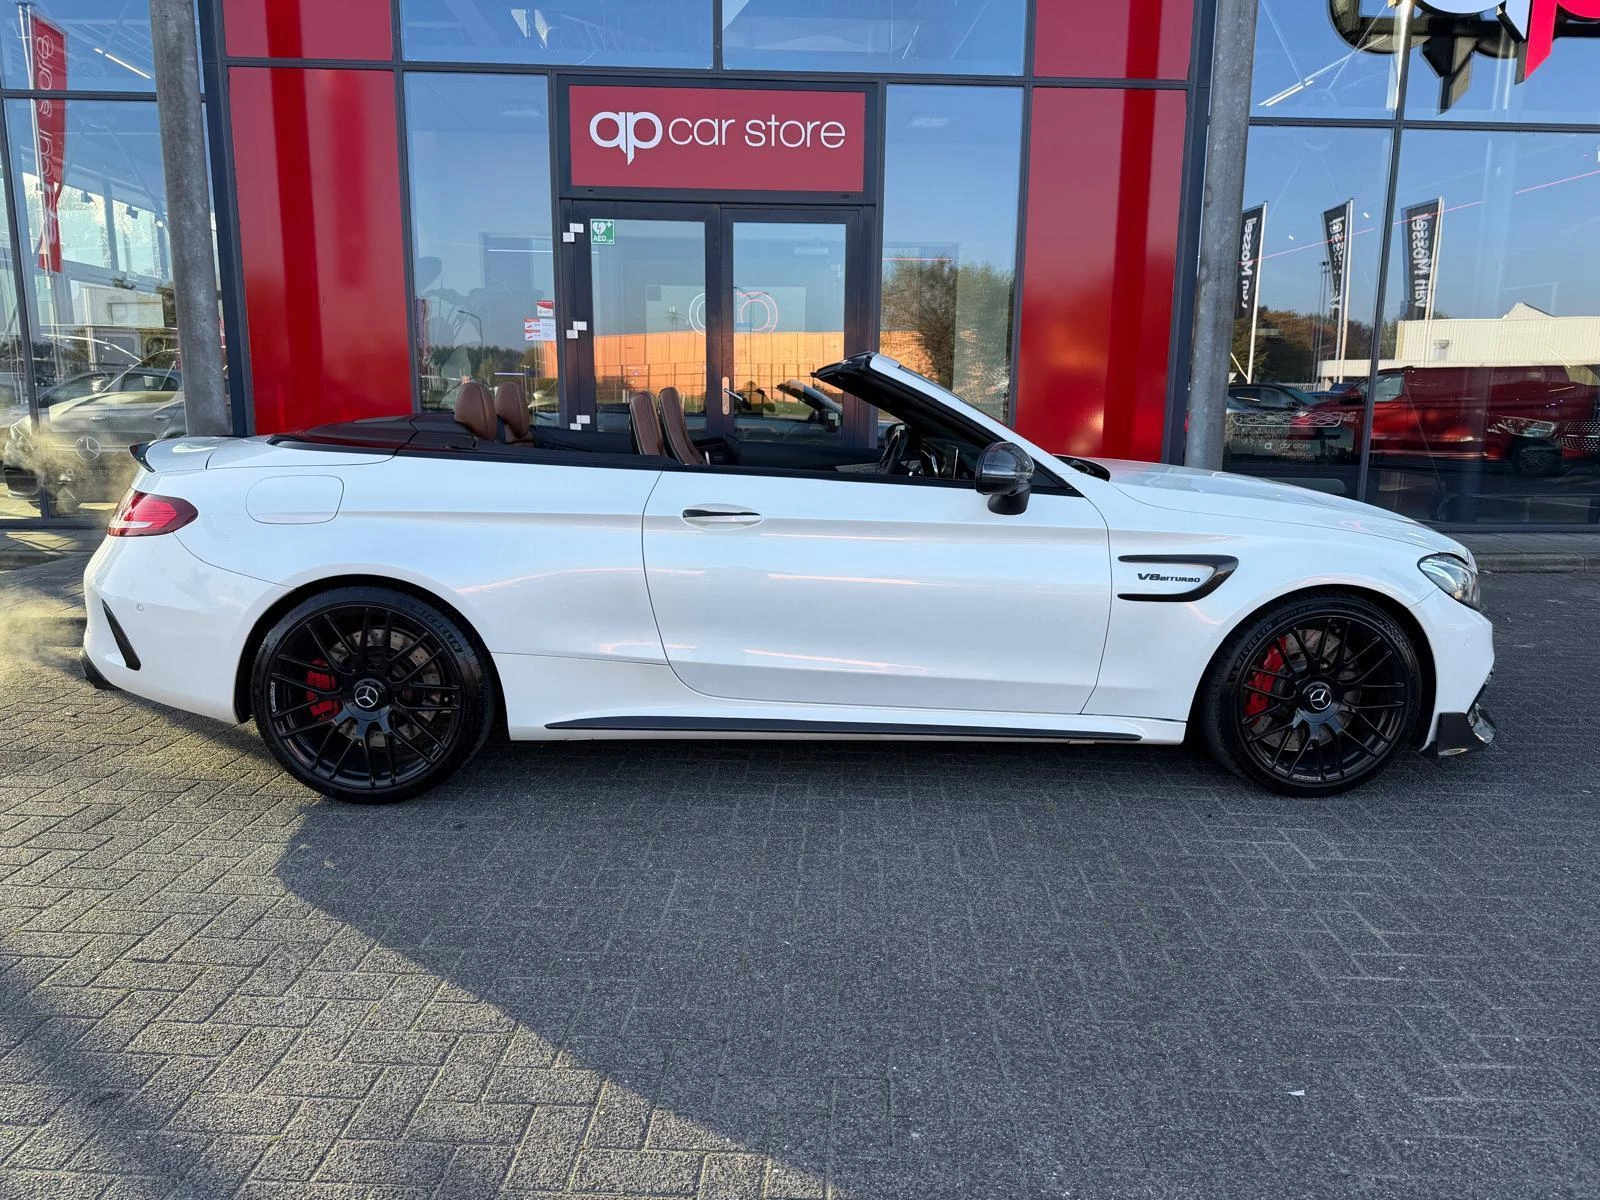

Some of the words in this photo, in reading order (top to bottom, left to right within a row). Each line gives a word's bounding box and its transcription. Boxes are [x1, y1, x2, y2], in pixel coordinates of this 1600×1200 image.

[589, 111, 663, 165] ap
[668, 117, 736, 146] car
[744, 114, 846, 149] store
[411, 605, 463, 653] MICHELIN
[1236, 624, 1273, 668] MICHELIN
